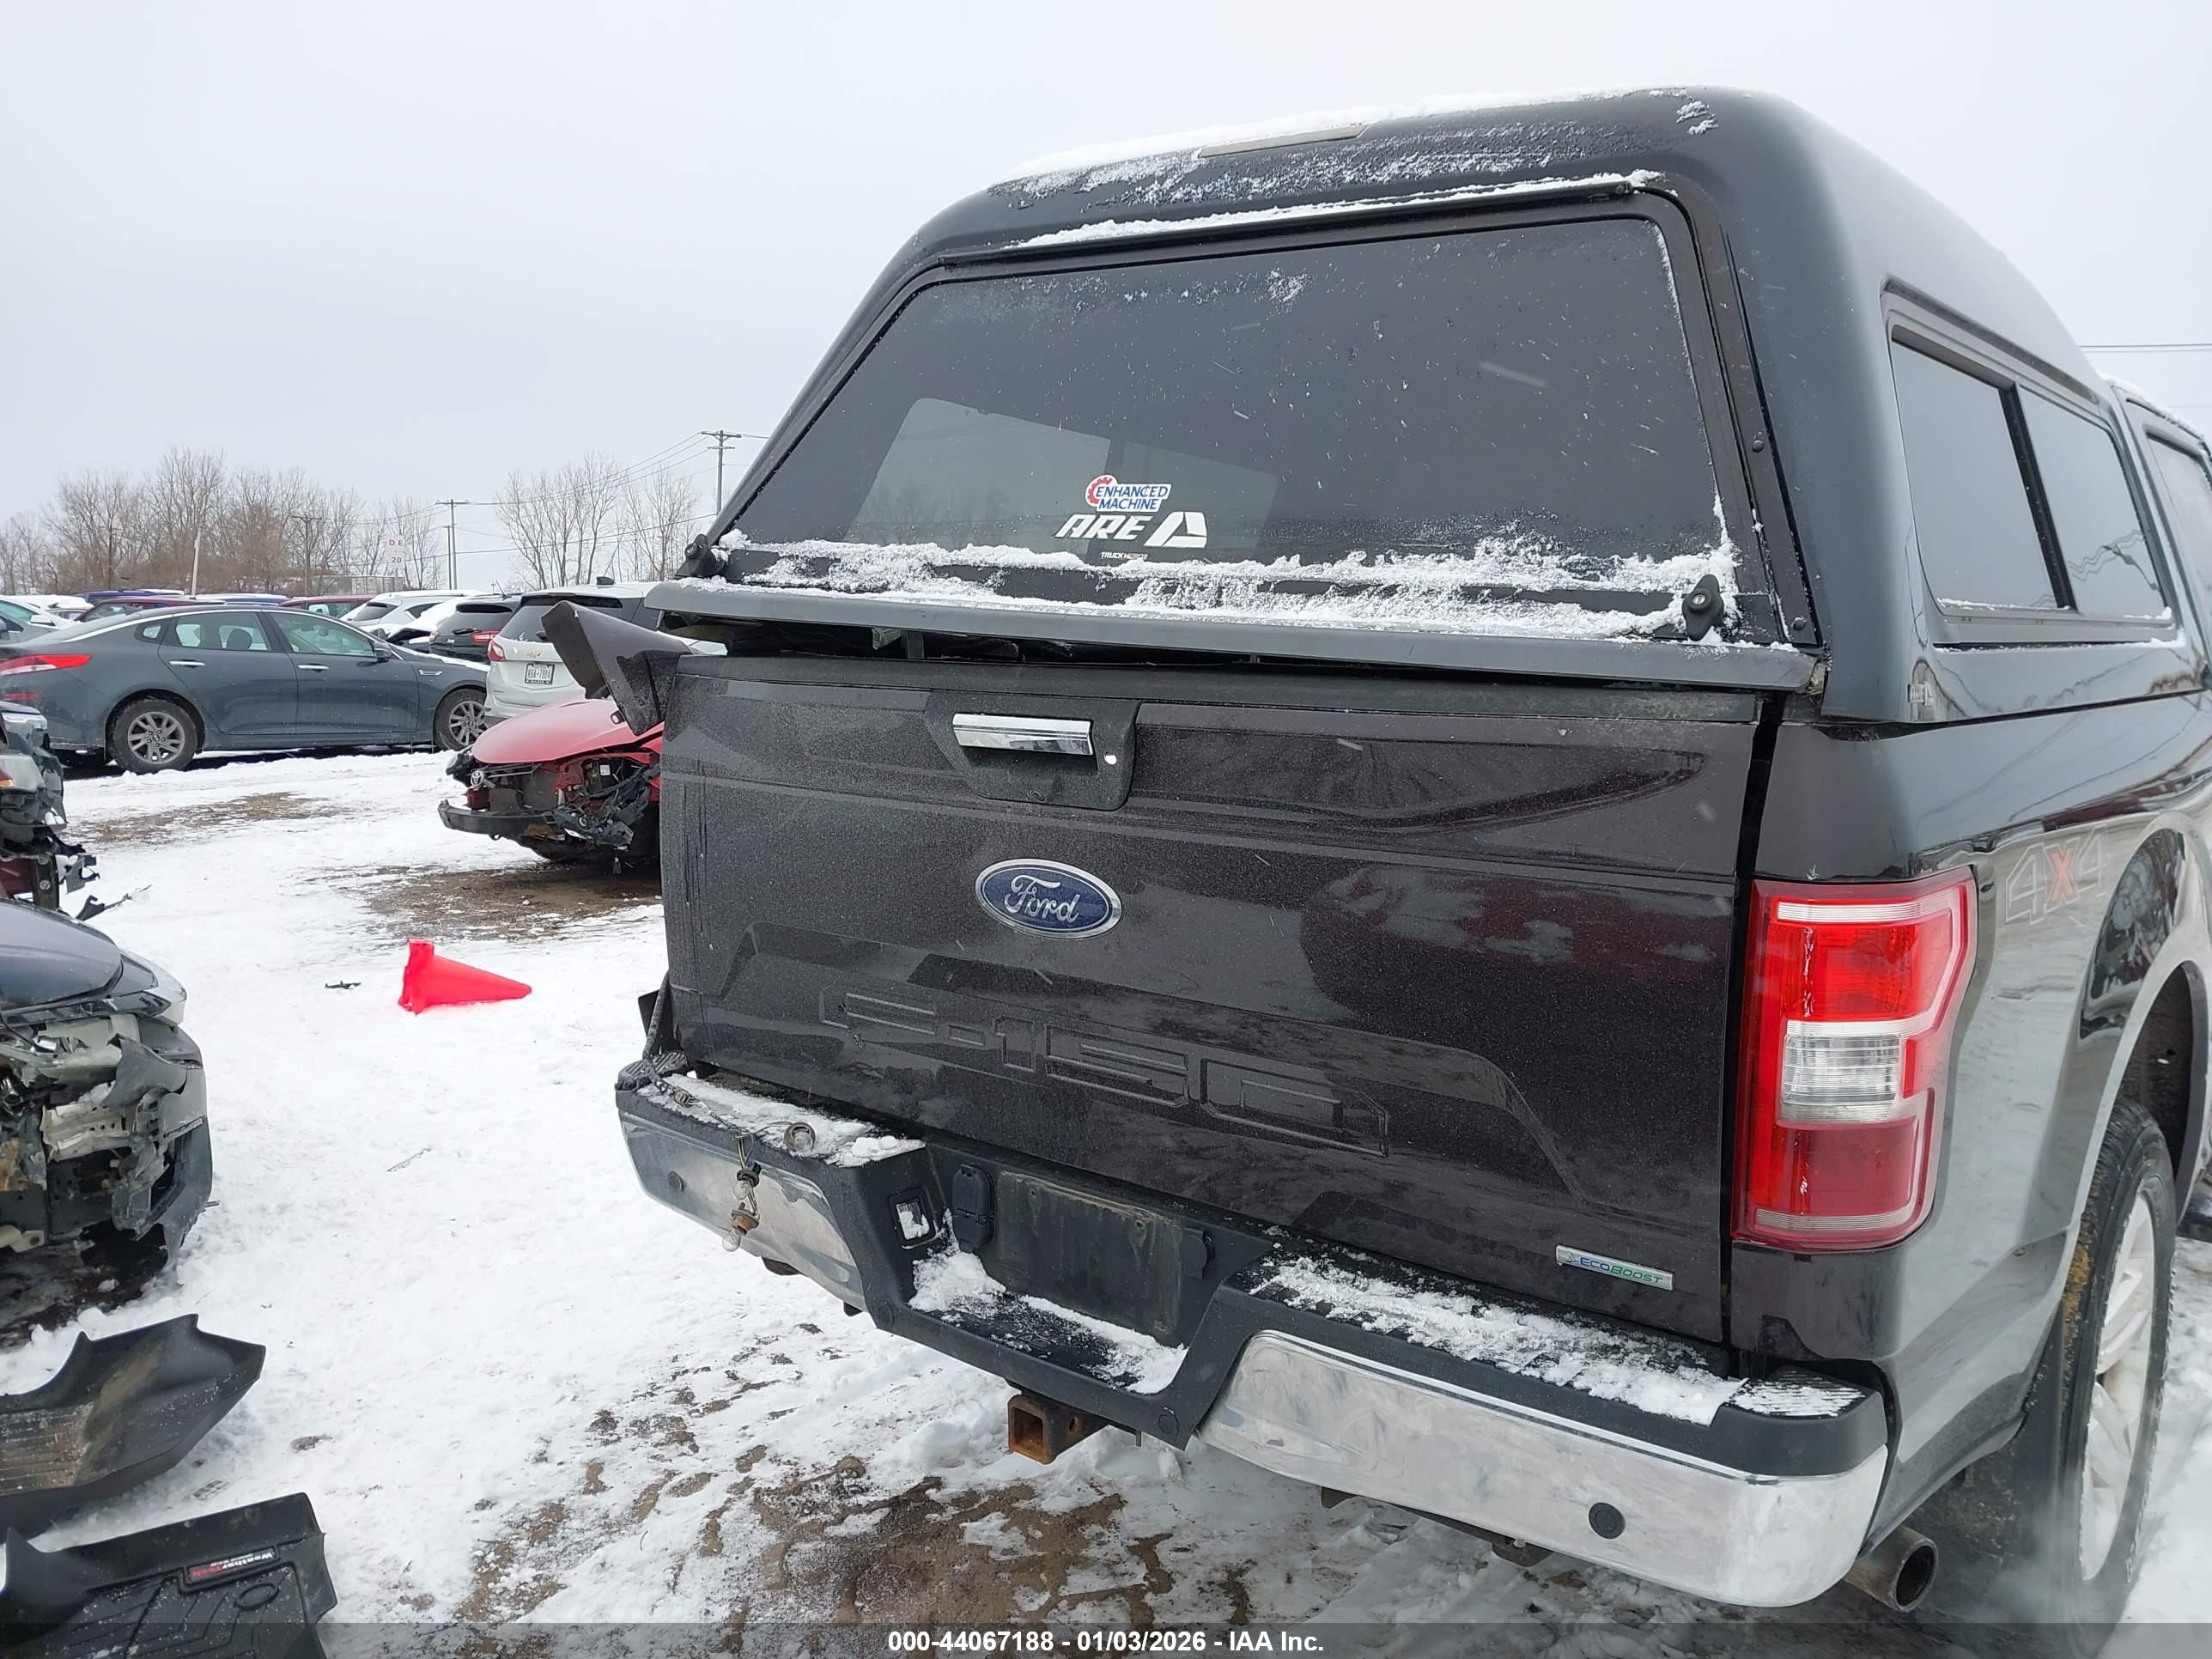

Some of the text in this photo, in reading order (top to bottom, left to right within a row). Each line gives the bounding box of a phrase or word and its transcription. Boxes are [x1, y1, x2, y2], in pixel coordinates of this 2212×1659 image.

[1096, 486, 1168, 497] ENHANCED
[1098, 499, 1158, 509] MACHINE
[1054, 514, 1153, 539] ARE
[1004, 874, 1080, 922] Ford
[1579, 1256, 1663, 1285] ECOBOOST
